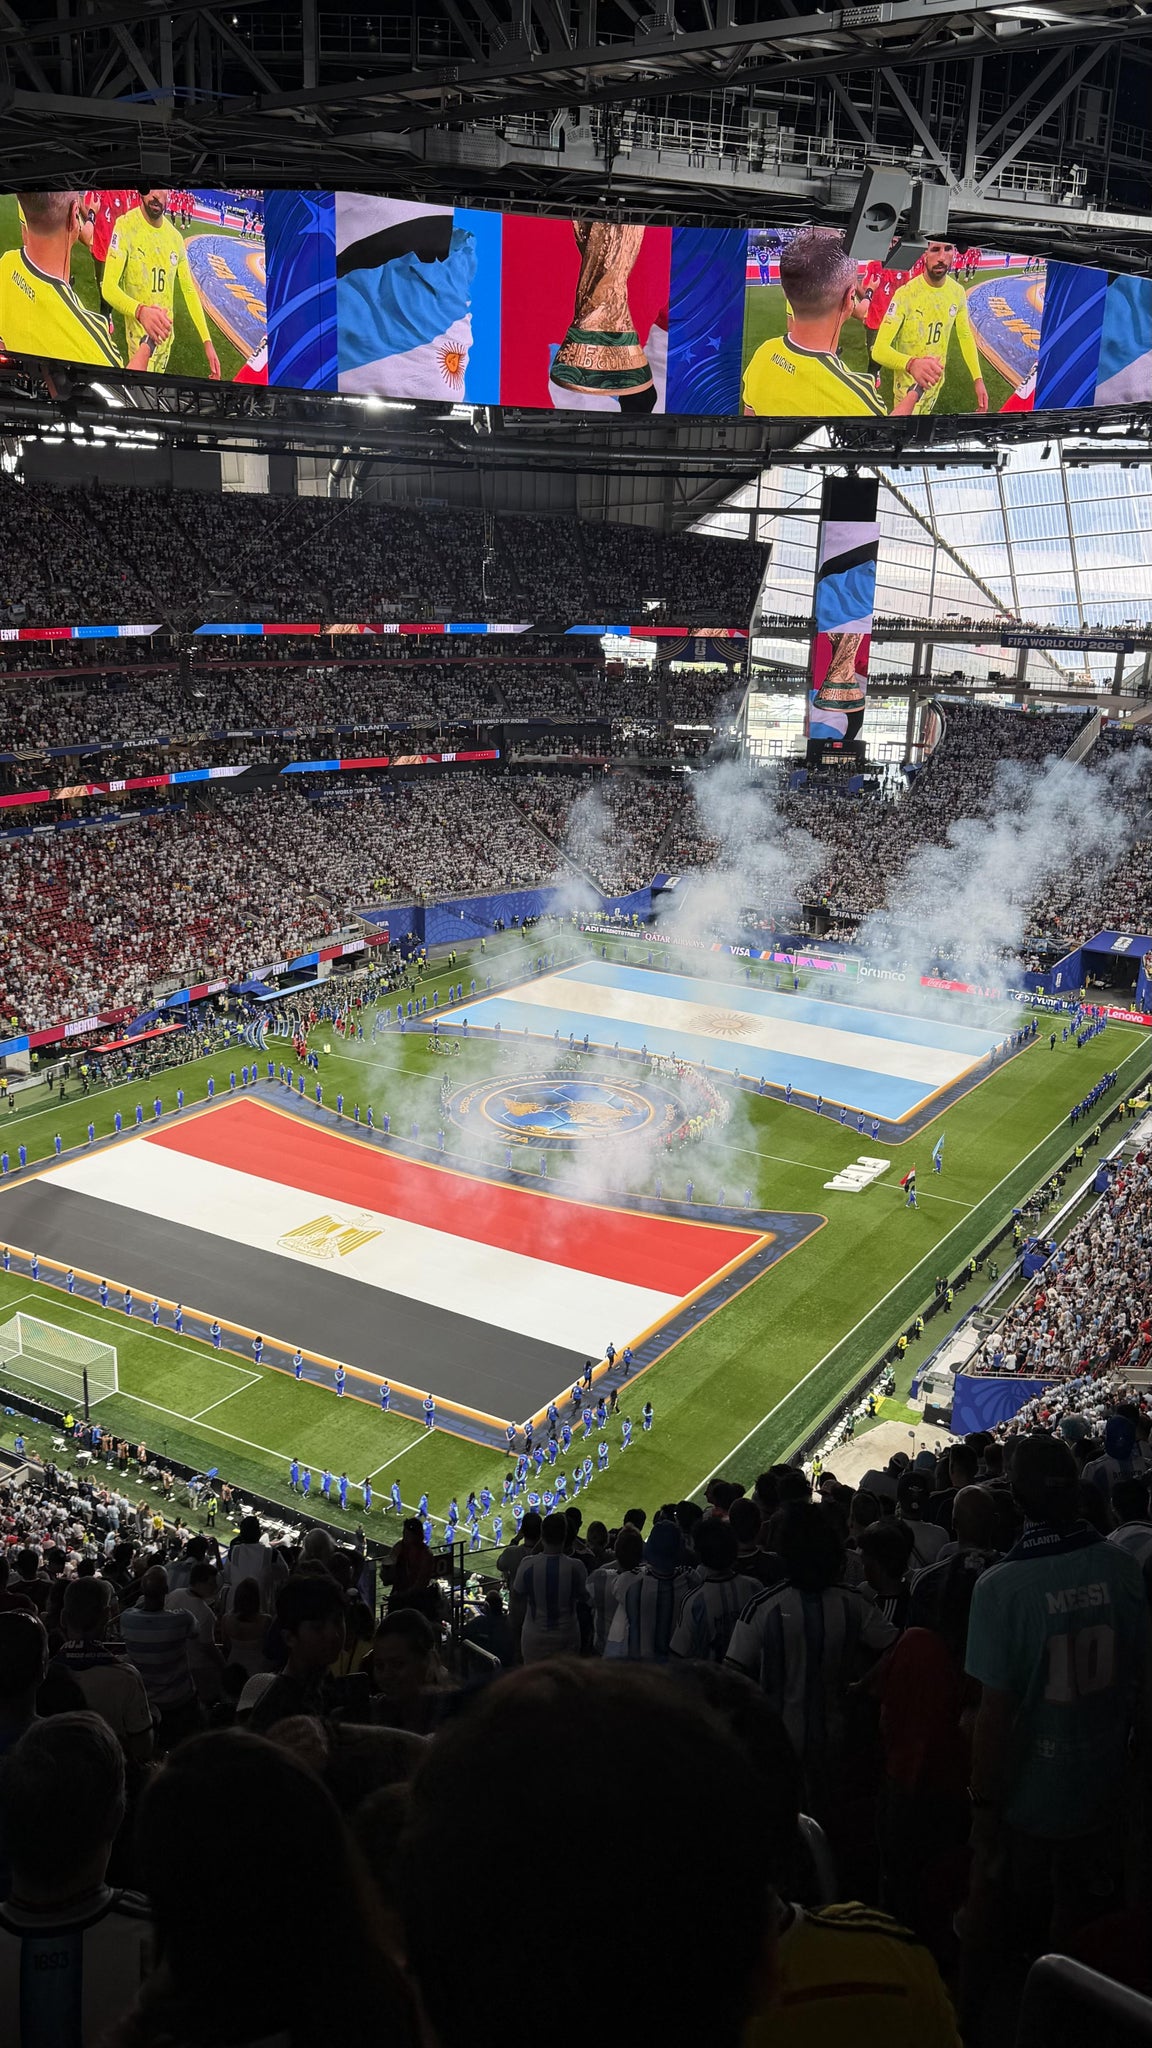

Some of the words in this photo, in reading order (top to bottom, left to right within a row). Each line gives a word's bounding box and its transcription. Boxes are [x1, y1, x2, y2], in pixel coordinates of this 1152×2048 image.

[12, 270, 36, 304] MUGNIER
[151, 267, 165, 293] 16
[926, 322, 943, 346] 16
[773, 353, 796, 376] MUGNIER
[1, 629, 20, 641] EGYPT
[383, 624, 400, 634] EGYPT
[1008, 637, 1029, 646] FIFA
[1030, 638, 1066, 648] WORLD
[1067, 640, 1088, 649] CUP
[1088, 641, 1125, 651] 2026
[122, 738, 160, 748] ATLANTA
[836, 910, 850, 919] FIFA
[851, 912, 877, 922] WORL
[585, 925, 599, 933] ADI
[645, 932, 671, 944] QATAR
[729, 945, 751, 958] VISA
[860, 967, 906, 982] aramco
[1107, 1008, 1144, 1023] Lenovo
[1023, 1534, 1061, 1549] ATLANTA
[1045, 1582, 1112, 1615] MESSI
[1044, 1623, 1116, 1703] 10
